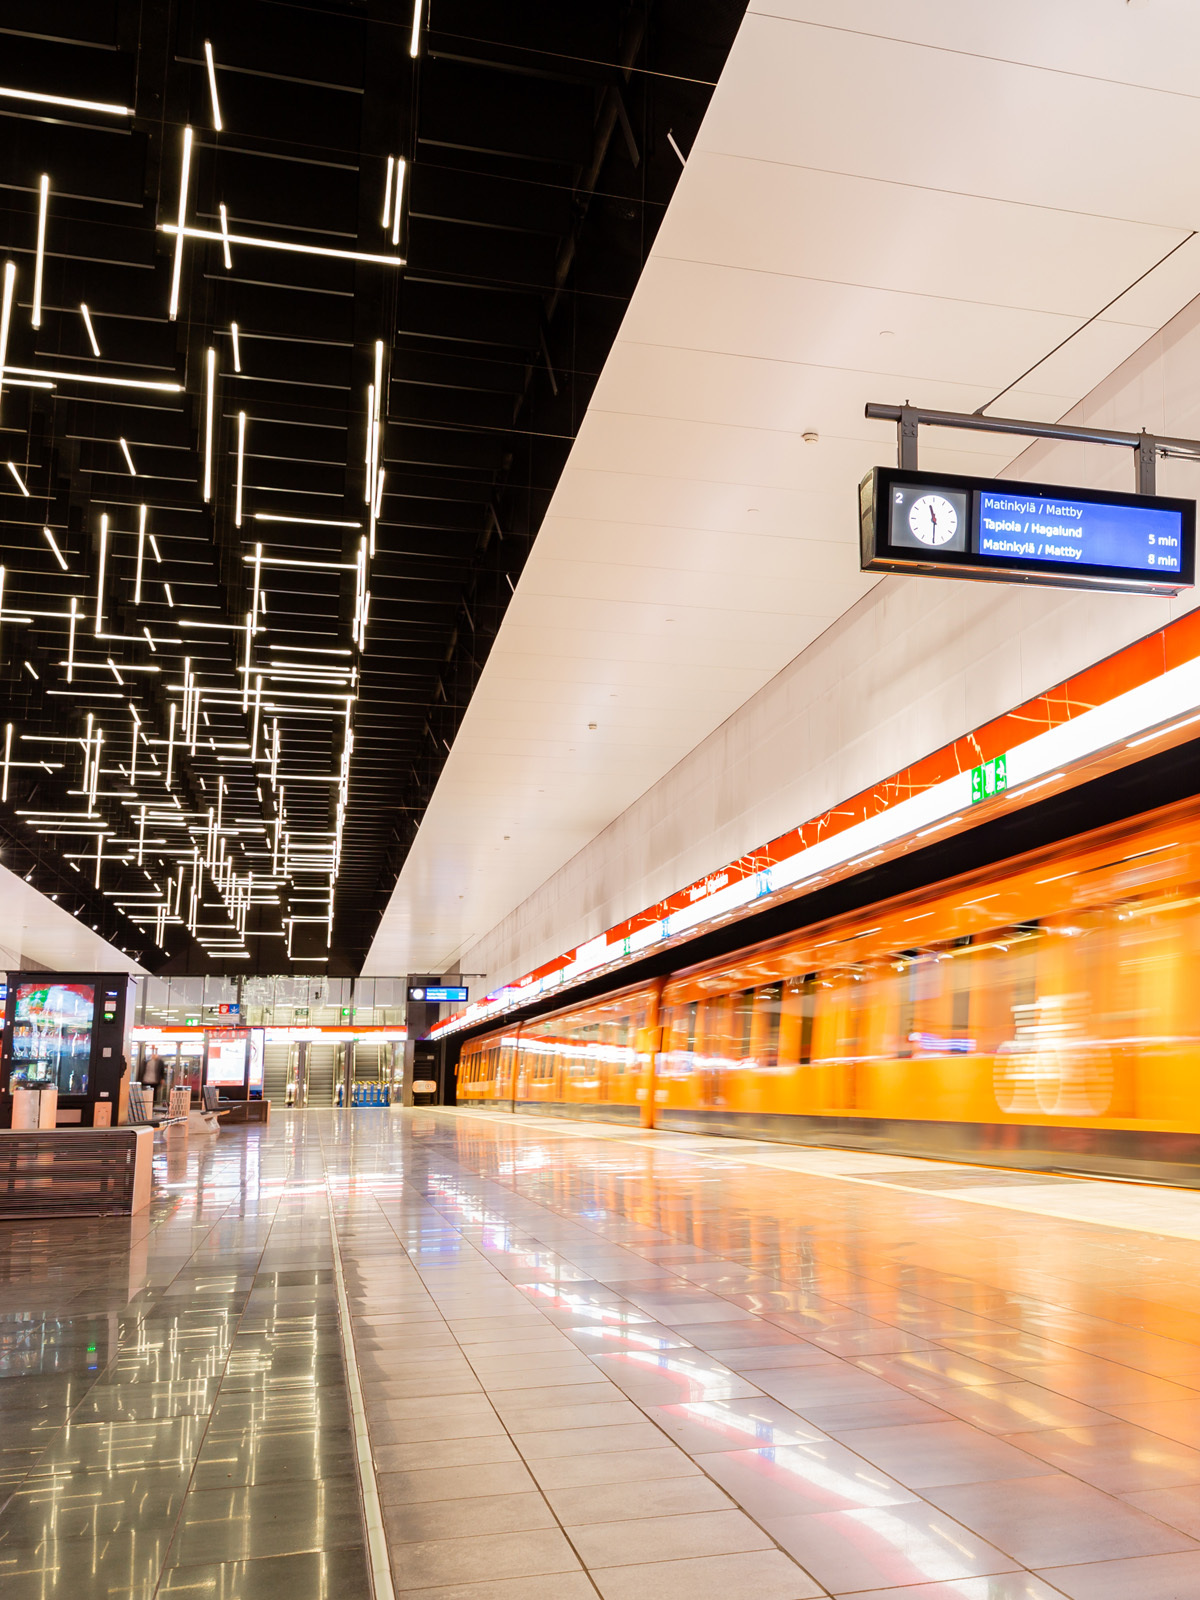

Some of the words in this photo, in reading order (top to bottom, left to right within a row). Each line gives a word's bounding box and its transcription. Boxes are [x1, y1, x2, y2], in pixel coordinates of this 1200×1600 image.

[895, 492, 903, 504] 2
[985, 498, 1036, 514] Matinkylä
[1038, 504, 1044, 514] /
[1046, 505, 1083, 519] Mattby
[983, 518, 1021, 532] Tapiola
[1024, 522, 1029, 534] /
[1031, 523, 1082, 538] Hagalund
[1148, 534, 1156, 545] 5
[1158, 535, 1178, 547] min
[983, 539, 1035, 555] Matinkylä
[1037, 544, 1043, 555] /
[1045, 545, 1082, 560] Mattby
[1147, 553, 1155, 565] 8
[1157, 555, 1178, 567] min
